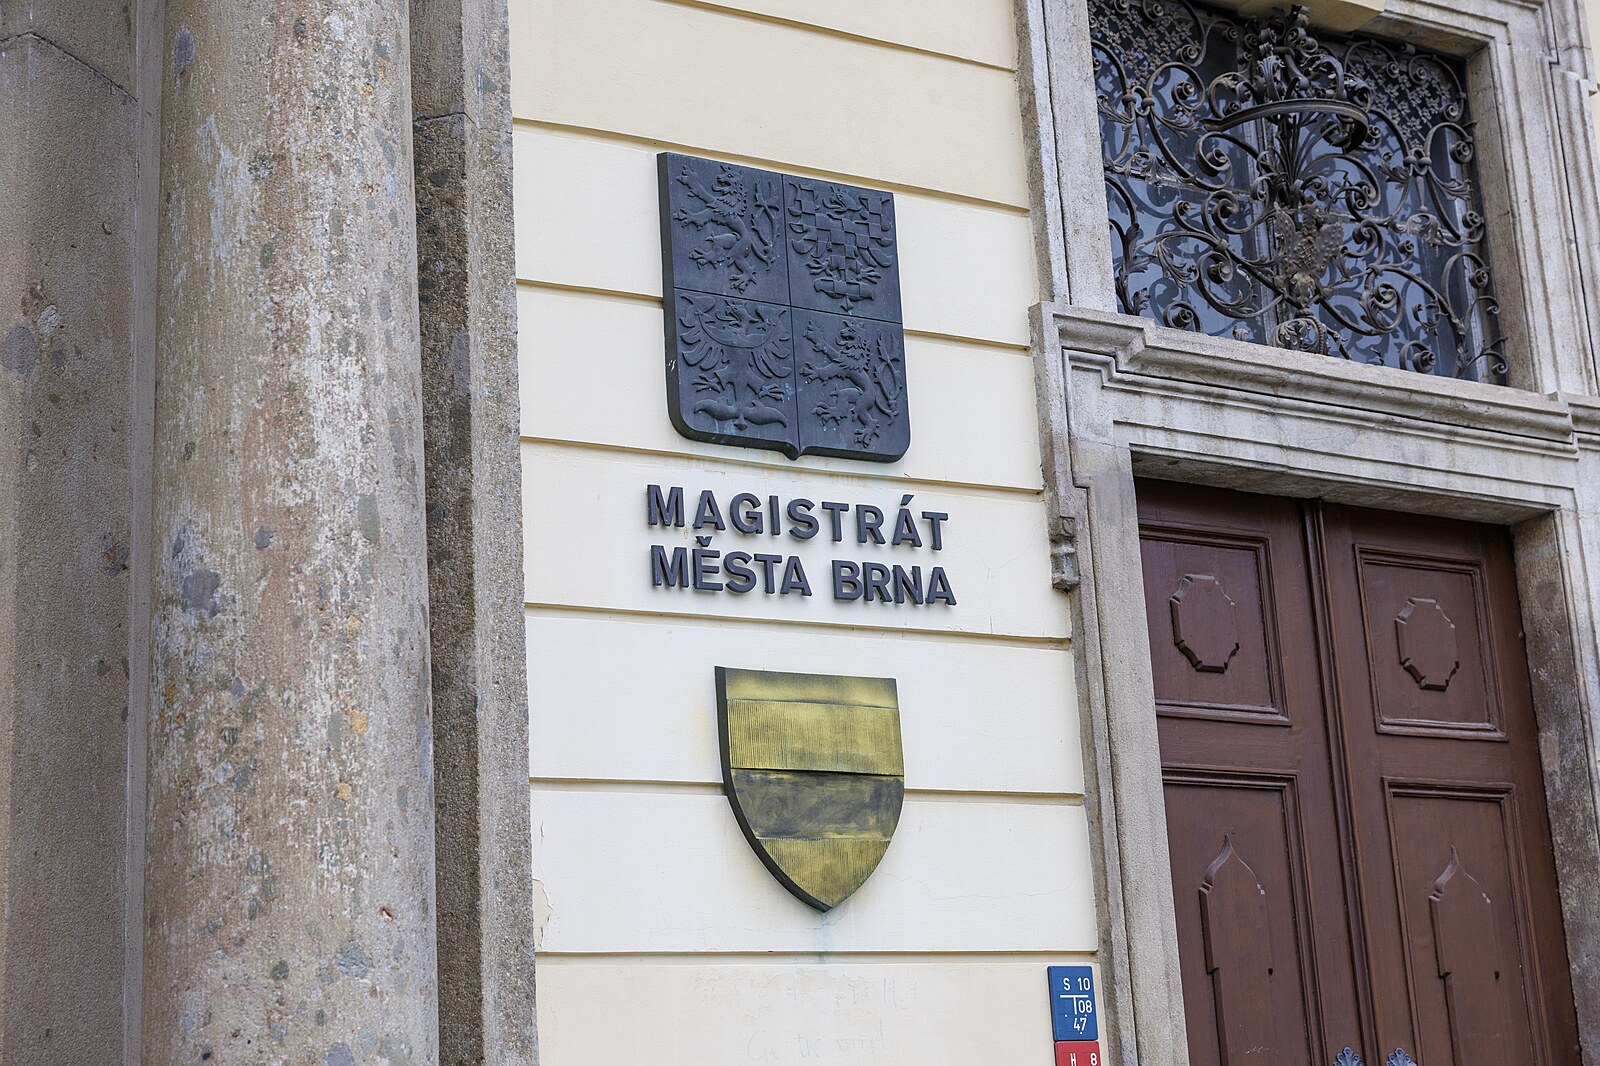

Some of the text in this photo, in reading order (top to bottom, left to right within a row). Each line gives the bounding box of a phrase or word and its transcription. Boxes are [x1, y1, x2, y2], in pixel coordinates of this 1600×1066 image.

[647, 484, 949, 551] MAGISTRÁT
[650, 535, 957, 605] MĚSTA BRNA
[1063, 977, 1091, 991] S 10
[1070, 1053, 1077, 1066] H
